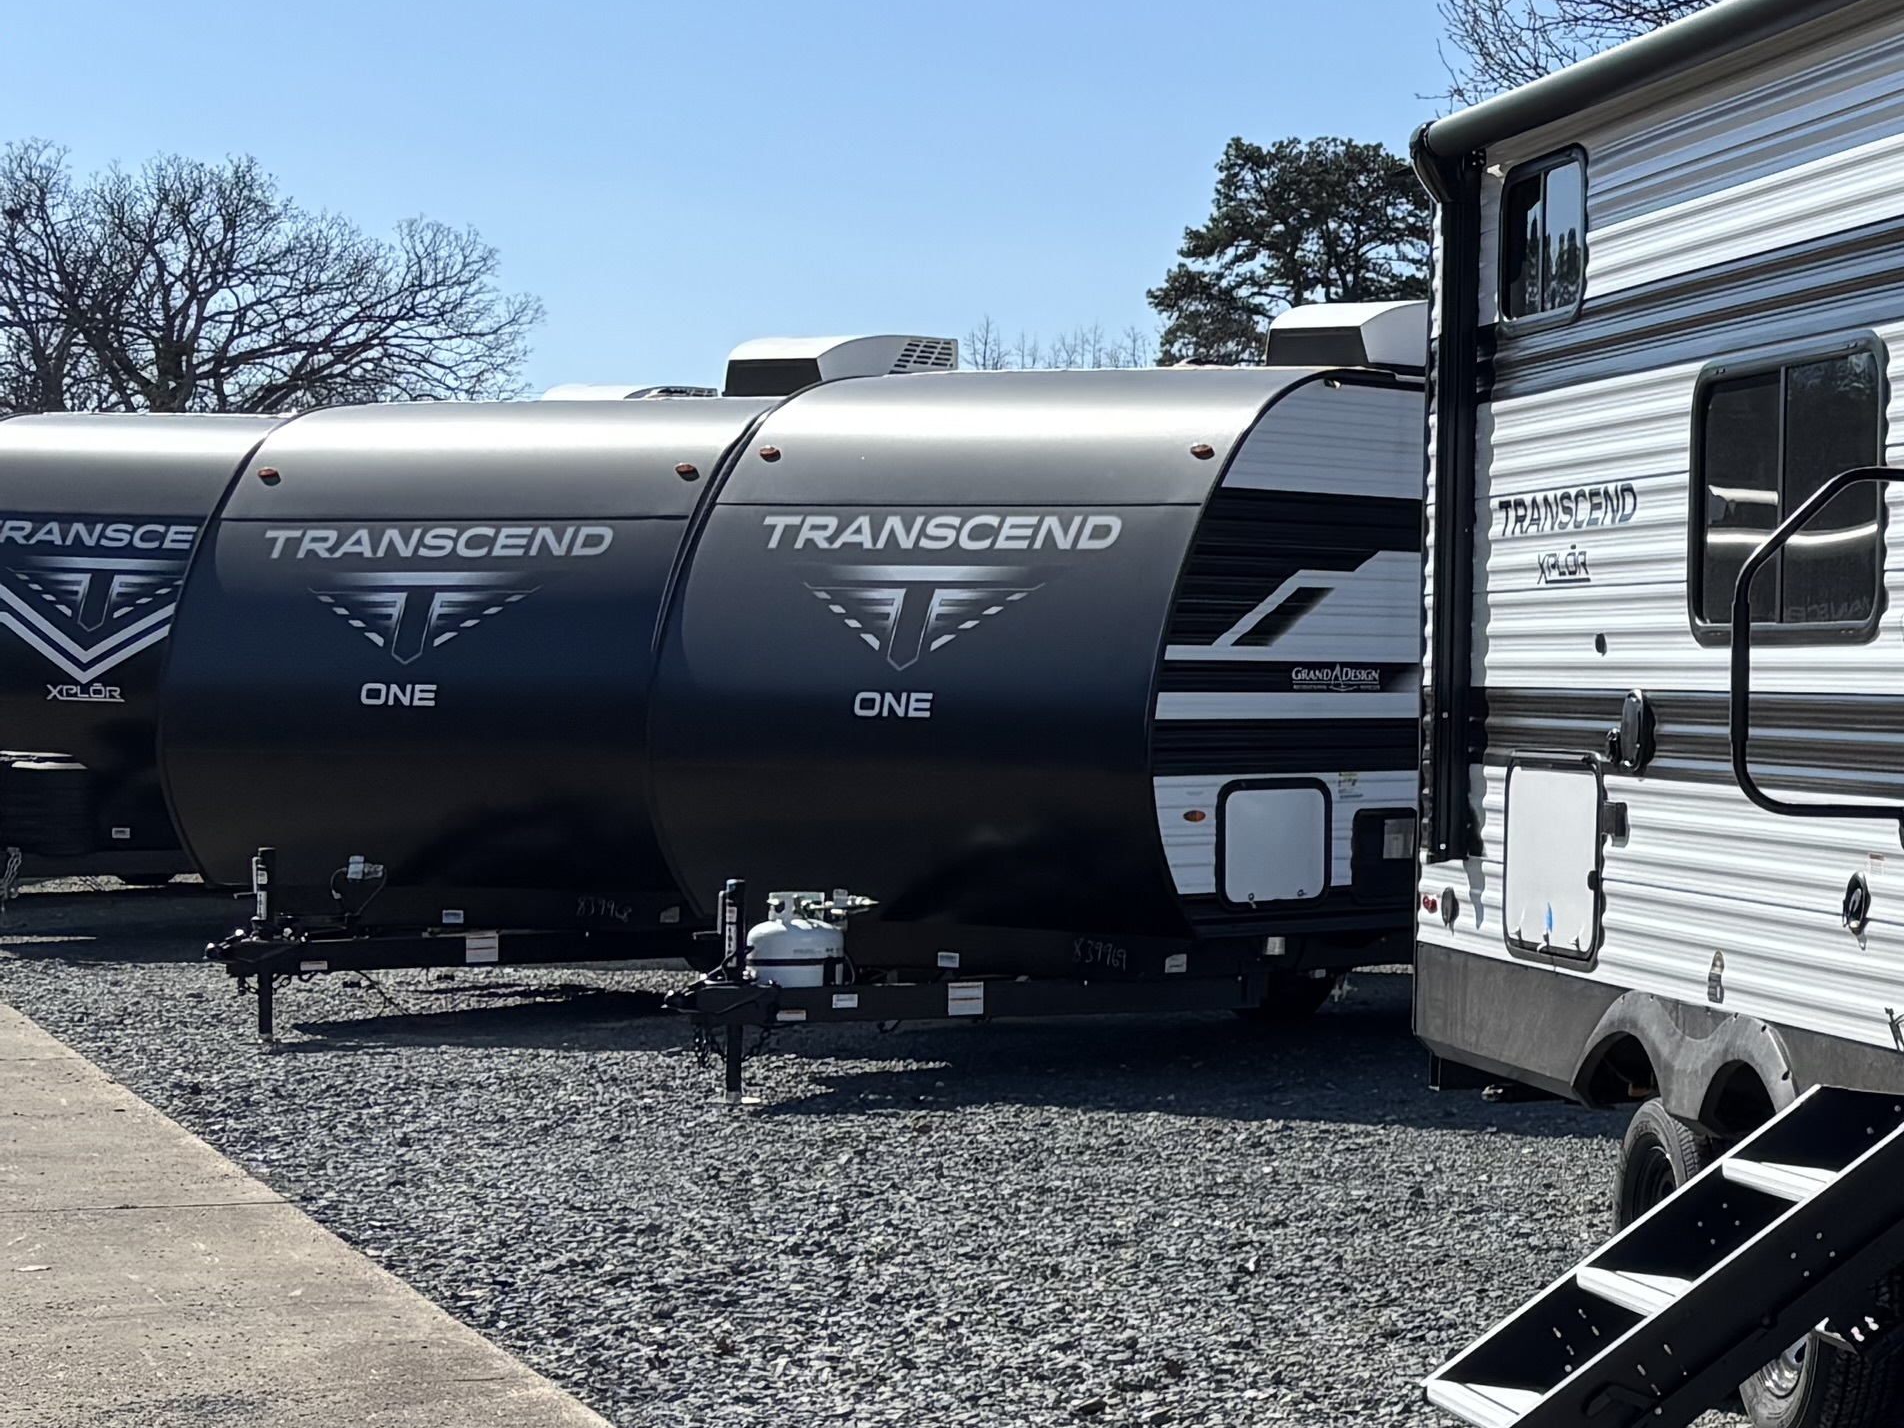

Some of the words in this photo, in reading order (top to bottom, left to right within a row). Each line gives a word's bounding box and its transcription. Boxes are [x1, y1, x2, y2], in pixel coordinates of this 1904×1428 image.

[1498, 482, 1638, 537] TRANSCEND
[0, 520, 198, 550] RANSCE
[264, 525, 614, 560] TRANSCEND
[762, 514, 1123, 551] TRANSCEND
[1291, 666, 1332, 681] GRAND
[1341, 667, 1380, 681] DESIGN
[360, 682, 438, 707] ONE
[853, 691, 934, 718] ONE
